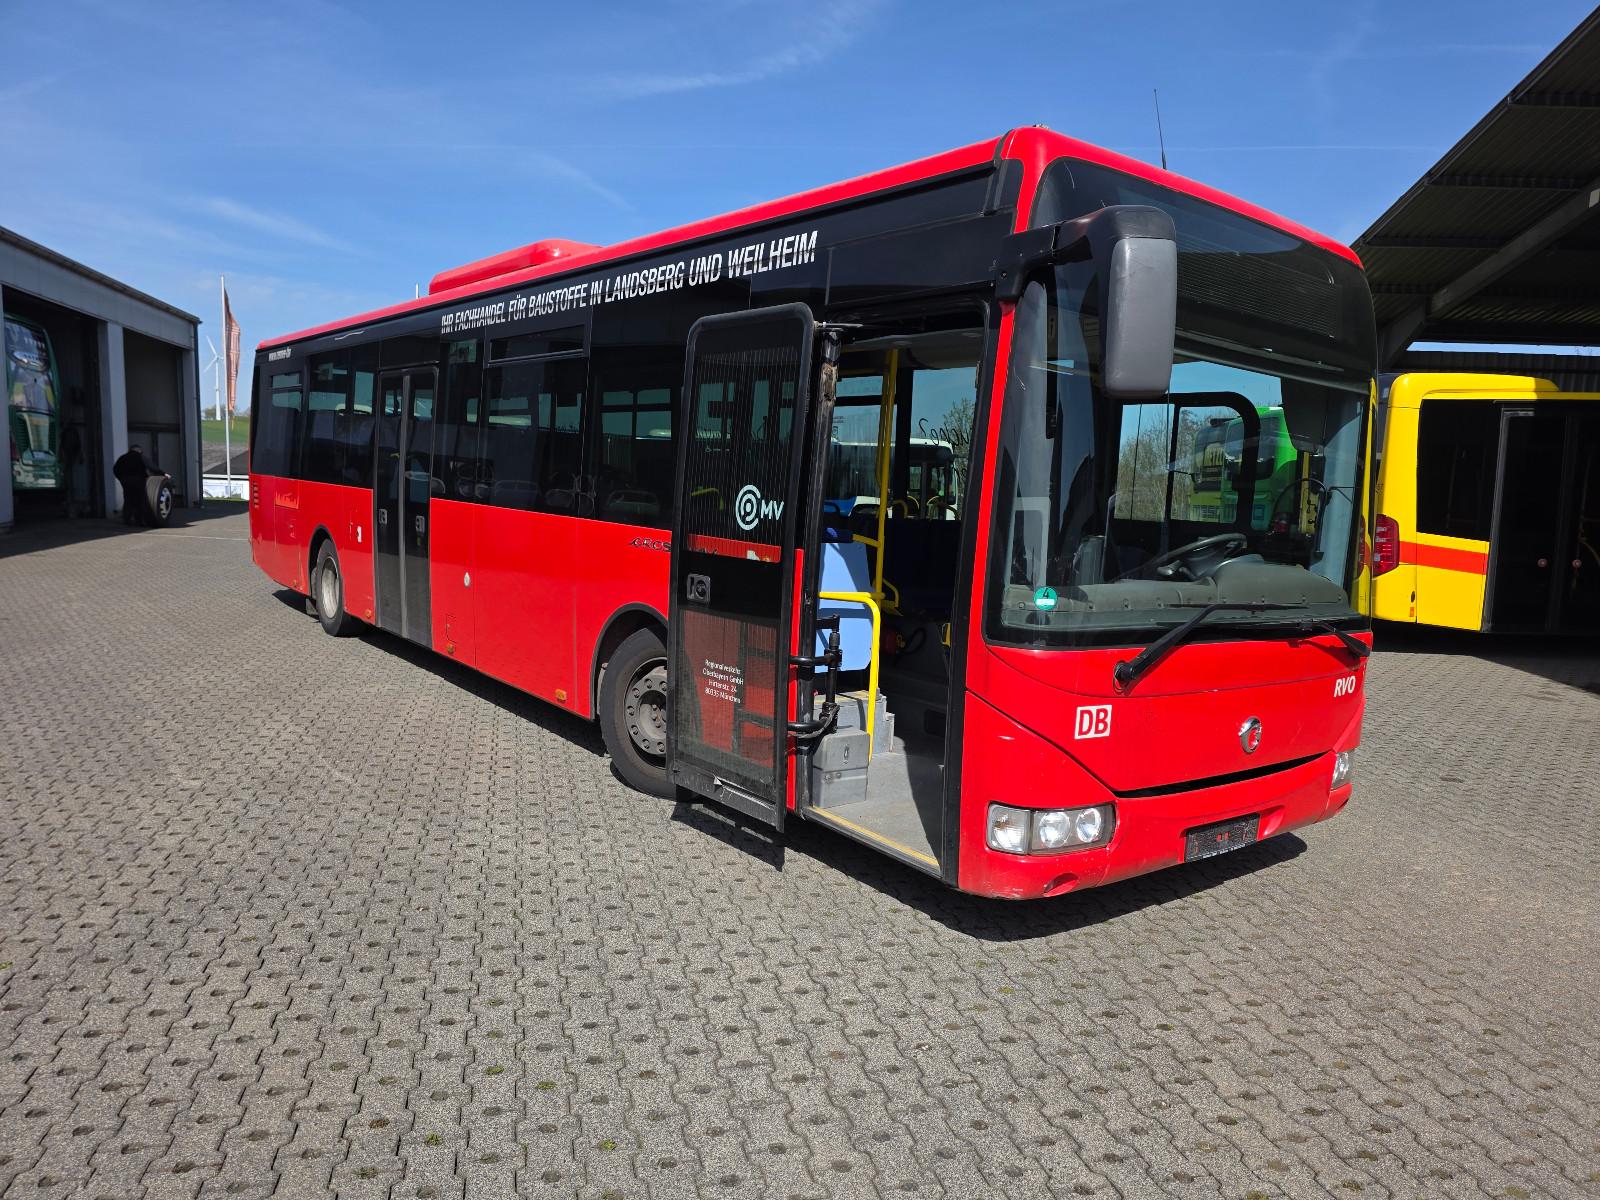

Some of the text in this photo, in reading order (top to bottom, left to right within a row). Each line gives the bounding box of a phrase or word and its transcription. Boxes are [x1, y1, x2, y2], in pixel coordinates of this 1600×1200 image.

[441, 230, 819, 335] IHR FACHHANDEL FÜR BAUSTOFFE IN LANDSBERG UND WEILHEIM
[729, 676, 744, 685] GmbH
[1333, 675, 1357, 698] RVO
[1077, 707, 1109, 737] DB
